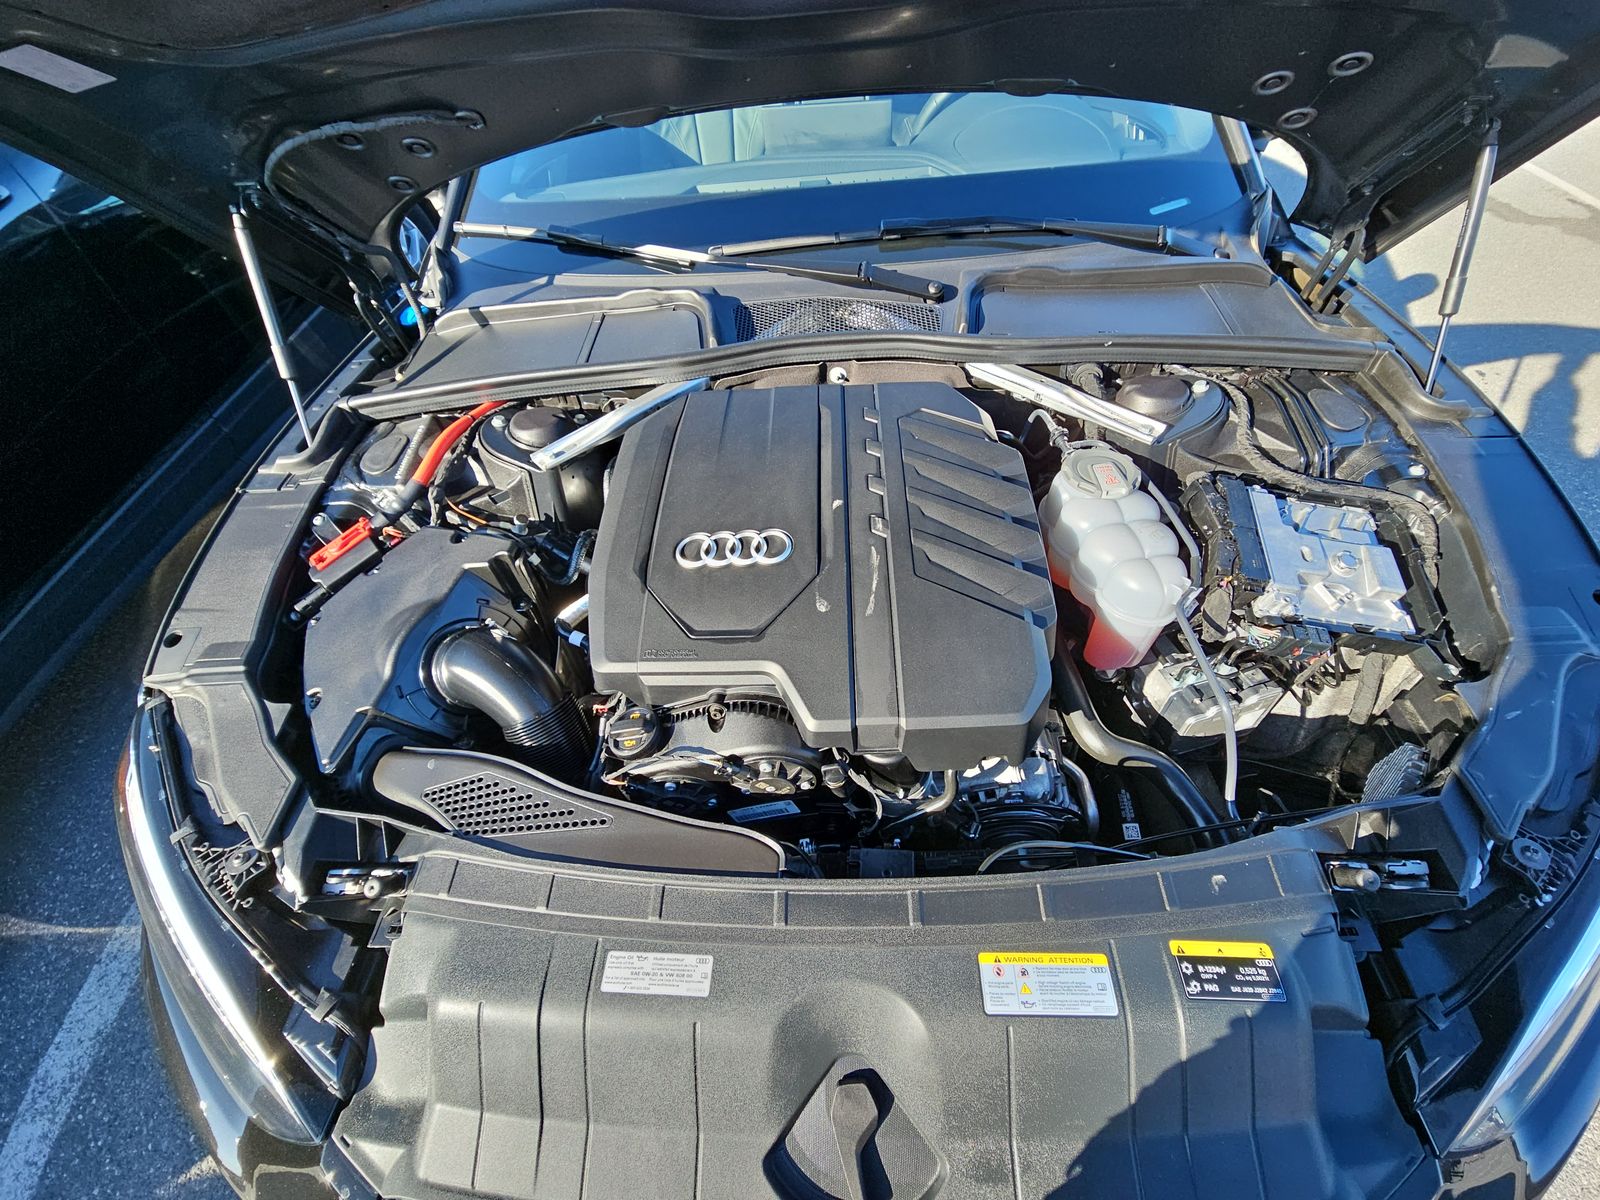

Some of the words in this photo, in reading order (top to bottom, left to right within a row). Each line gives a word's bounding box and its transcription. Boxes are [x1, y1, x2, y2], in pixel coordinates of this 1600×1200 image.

[1048, 956, 1094, 964] ATTENTION
[1197, 965, 1226, 974] R-1234yf
[1257, 968, 1267, 976] kg
[1203, 983, 1219, 992] PAG
